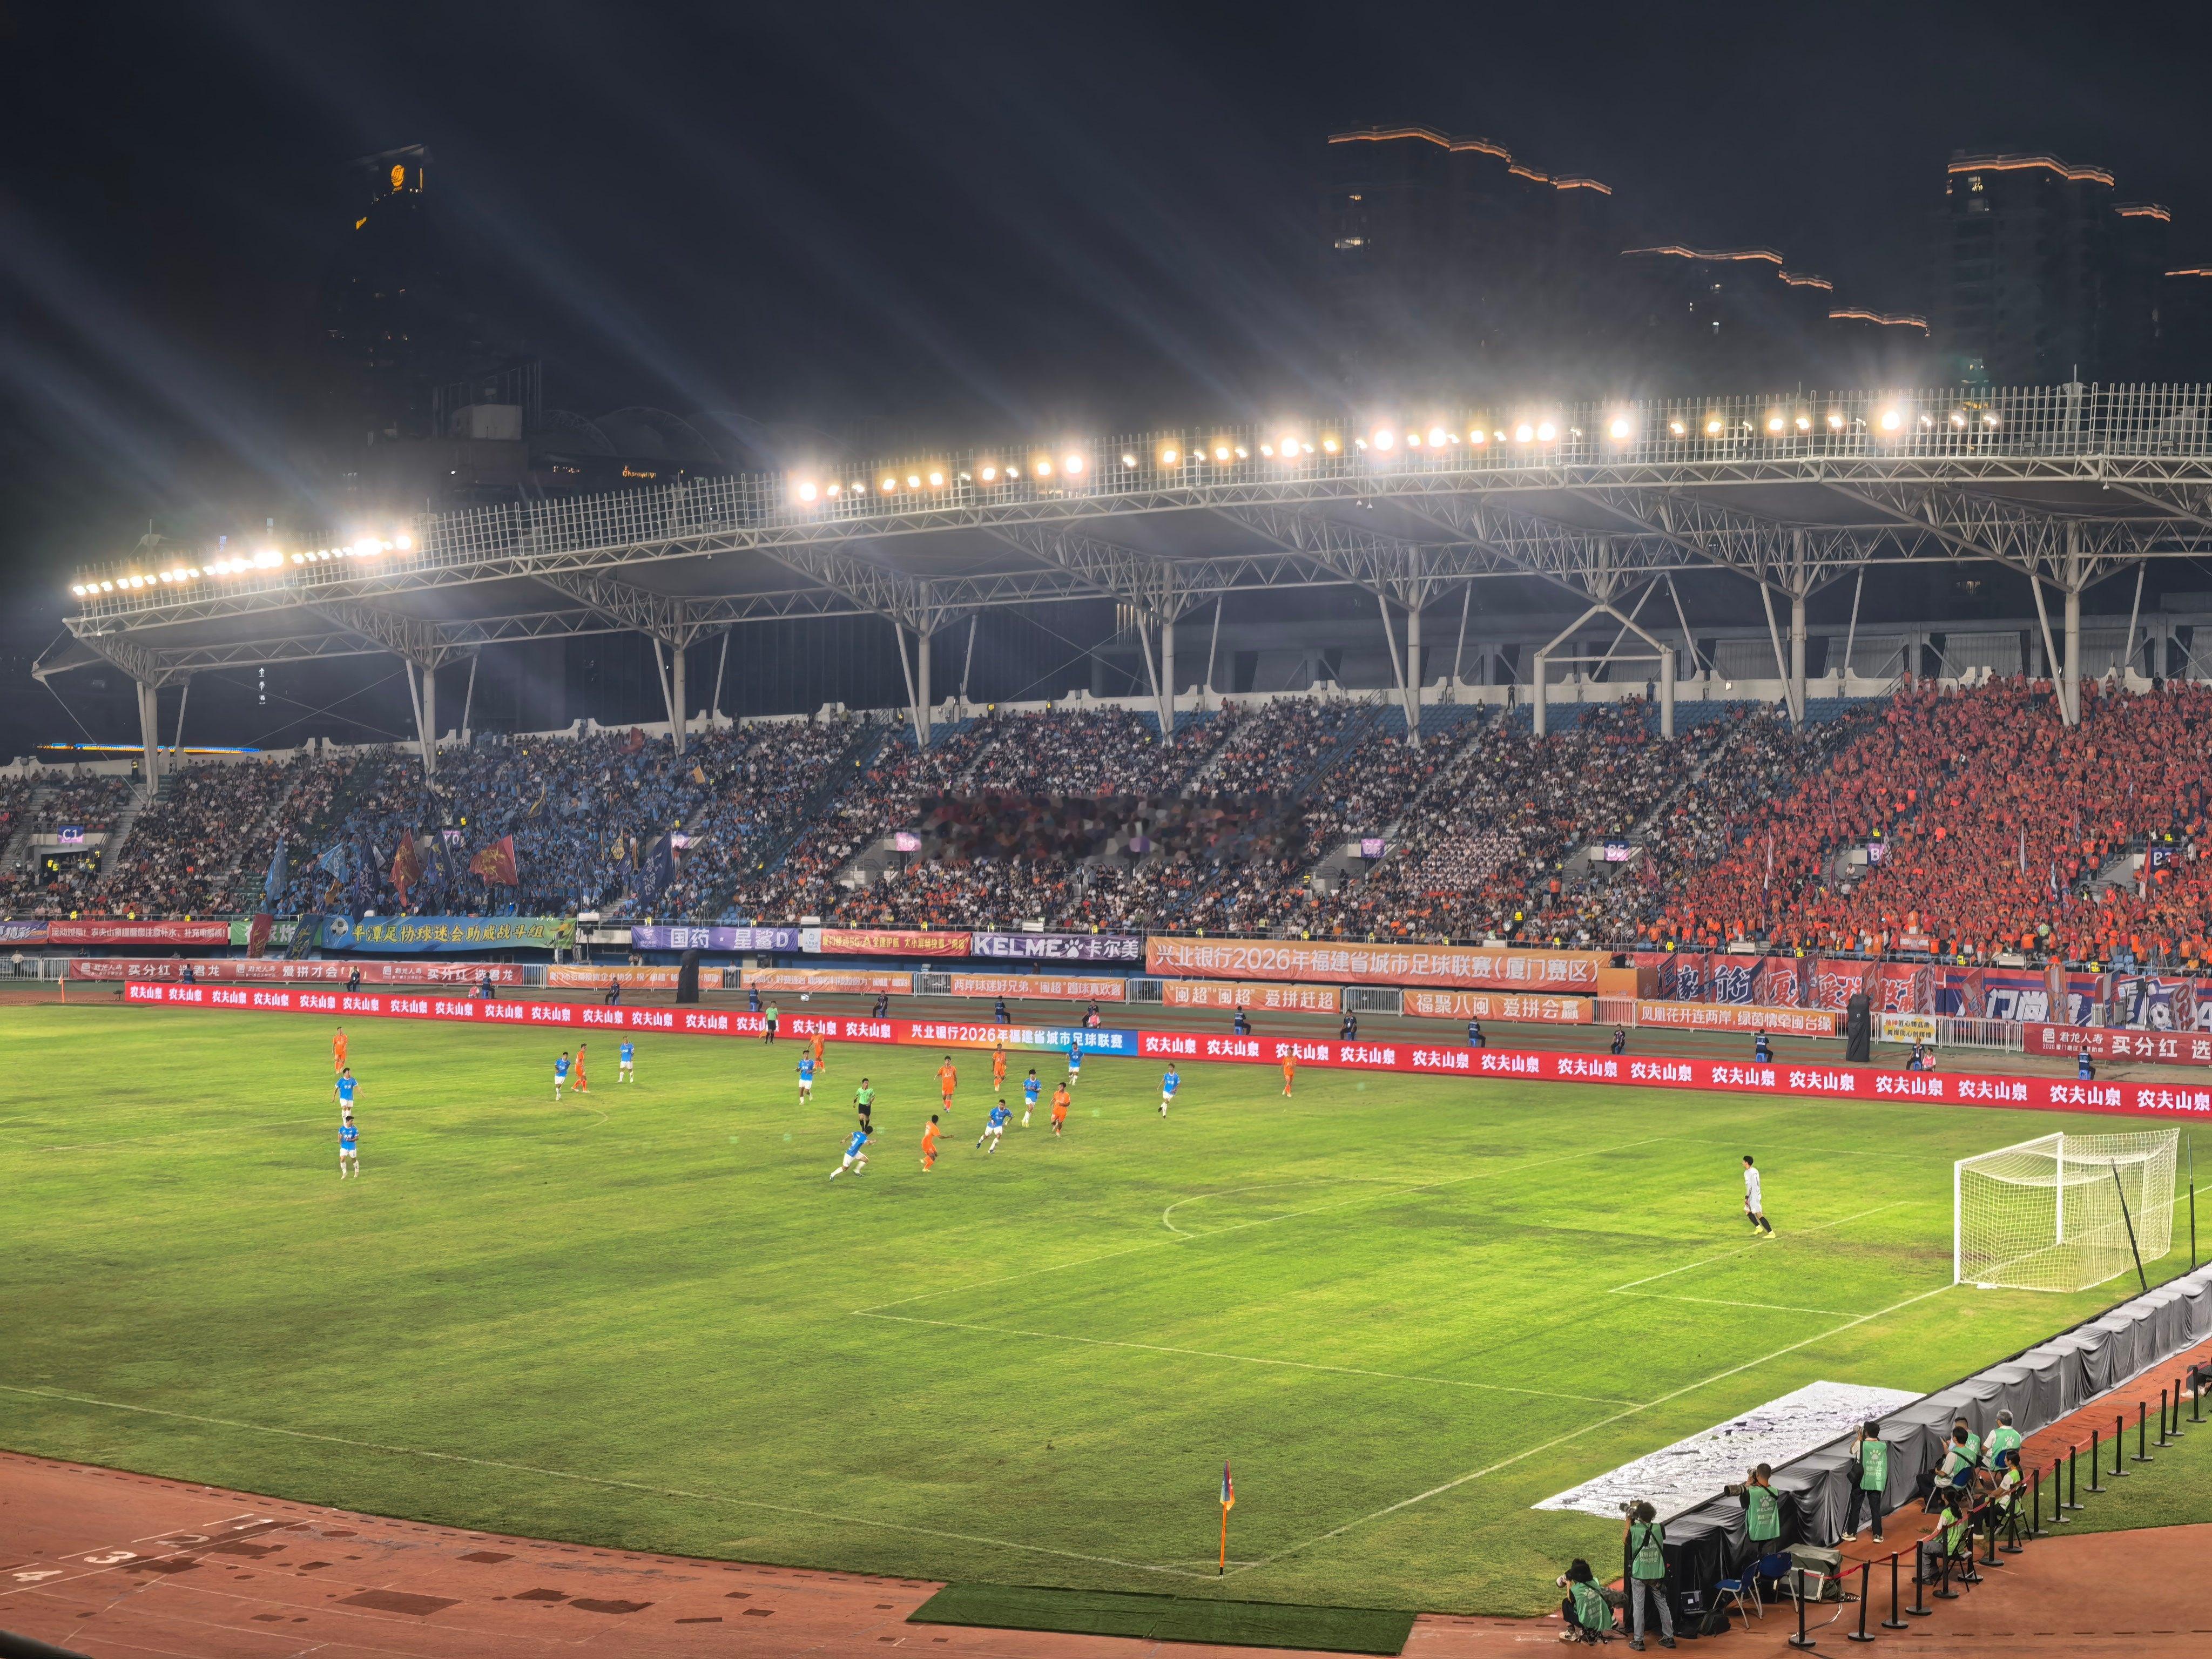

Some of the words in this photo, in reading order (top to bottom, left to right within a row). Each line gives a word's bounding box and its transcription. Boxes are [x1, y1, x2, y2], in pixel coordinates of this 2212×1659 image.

[63, 829, 77, 840] C1
[352, 924, 544, 943] 平潭足协球迷会助威战斗组
[974, 937, 1062, 957] KELME
[1085, 940, 1139, 958] 卡尔美
[128, 965, 171, 976] 买分红
[427, 967, 467, 981] 买分红
[130, 986, 163, 1000] 农夫山泉
[168, 988, 203, 1002] 农夫山泉
[212, 990, 247, 1004] 农夫山泉
[254, 992, 289, 1007] 农夫山泉
[1265, 989, 1334, 1010] 爱拼赶超
[300, 995, 335, 1009] 农夫山泉
[343, 997, 379, 1011] 农夫山泉
[391, 1000, 427, 1014] 农夫山泉
[435, 1002, 473, 1016] 农夫山泉
[1417, 993, 1489, 1015] 福聚八闽
[1503, 997, 1579, 1020] 爱拼会赢
[485, 1004, 523, 1019] 农夫山泉
[532, 1007, 570, 1021] 农夫山泉
[583, 1009, 623, 1024] 农夫山泉
[632, 1011, 672, 1027] 农夫山泉
[686, 1014, 727, 1029] 农夫山泉
[792, 1019, 837, 1035] 农夫山泉
[846, 1022, 891, 1038] 农夫山泉
[912, 1024, 1122, 1049] 兴业银行2026年福建省城市足球联赛
[1146, 1037, 1196, 1054] 农夫山泉
[1207, 1040, 1259, 1057] 农夫山泉
[1276, 1043, 1329, 1061] 农夫山泉
[2060, 1031, 2103, 1044] 君龙人寿
[2112, 1035, 2177, 1057] 买分红
[2191, 1040, 2211, 1060] 选
[1341, 1046, 1395, 1064] 农夫山泉
[1413, 1050, 1469, 1069] 农夫山泉
[1481, 1054, 1540, 1073] 农夫山泉
[1557, 1058, 1617, 1077] 农夫山泉
[1631, 1062, 1692, 1082] 农夫山泉
[1712, 1066, 1775, 1087] 农夫山泉
[1789, 1070, 1855, 1091] 农夫山泉
[1876, 1075, 1943, 1096] 农夫山泉
[1958, 1080, 2027, 1101] 农夫山泉
[2050, 1084, 2121, 1106] 农夫山泉
[2137, 1089, 2210, 1111] 农夫山泉
[84, 1551, 138, 1564] 3
[12, 1570, 63, 1582] 4
